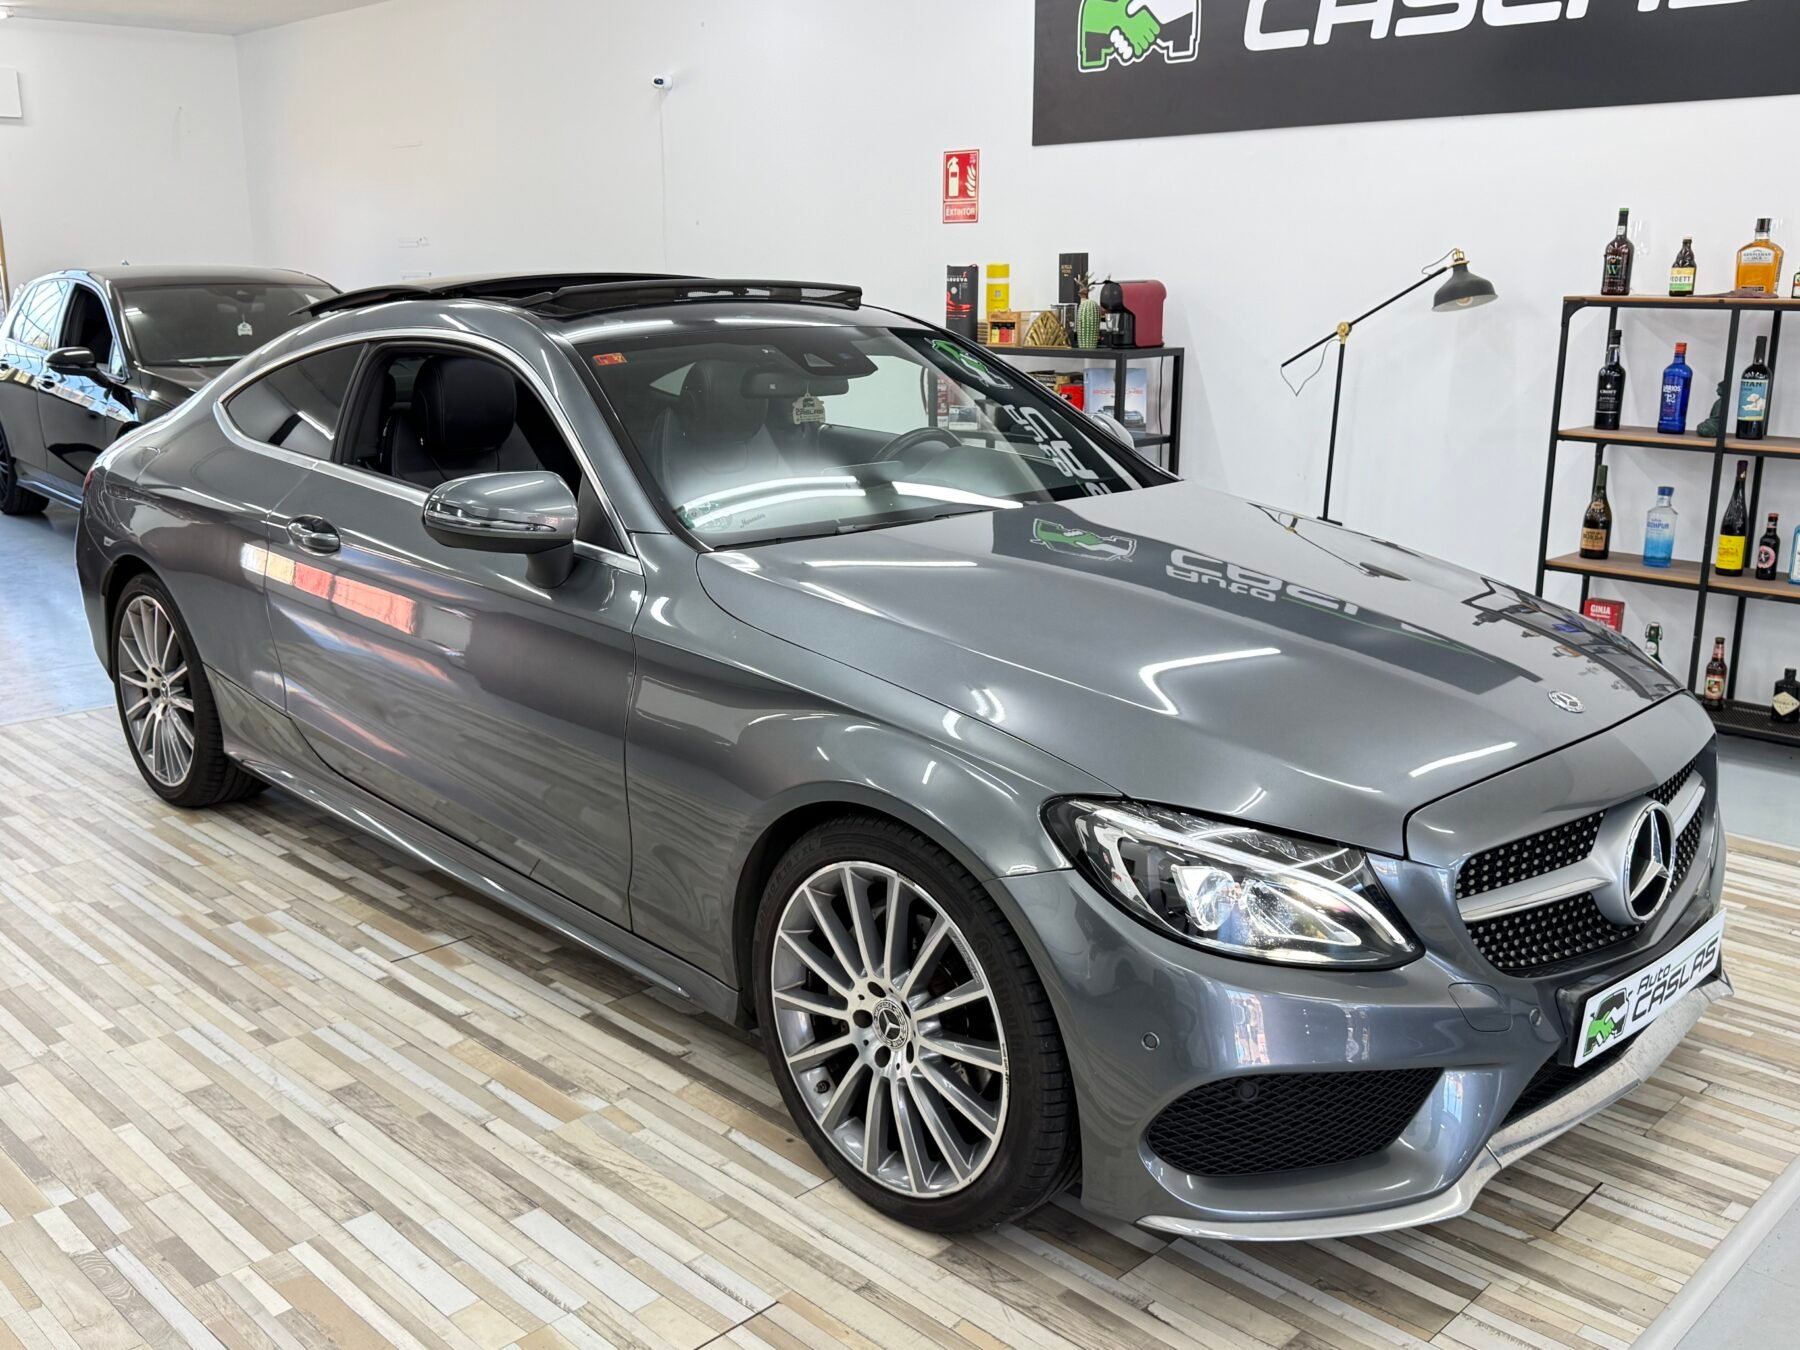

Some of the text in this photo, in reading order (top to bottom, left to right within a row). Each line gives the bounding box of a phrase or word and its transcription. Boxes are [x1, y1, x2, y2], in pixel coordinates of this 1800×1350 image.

[1244, 0, 1752, 51] CAS
[945, 206, 976, 217] EXTINTOR
[1631, 936, 1719, 1022] CASLAS
